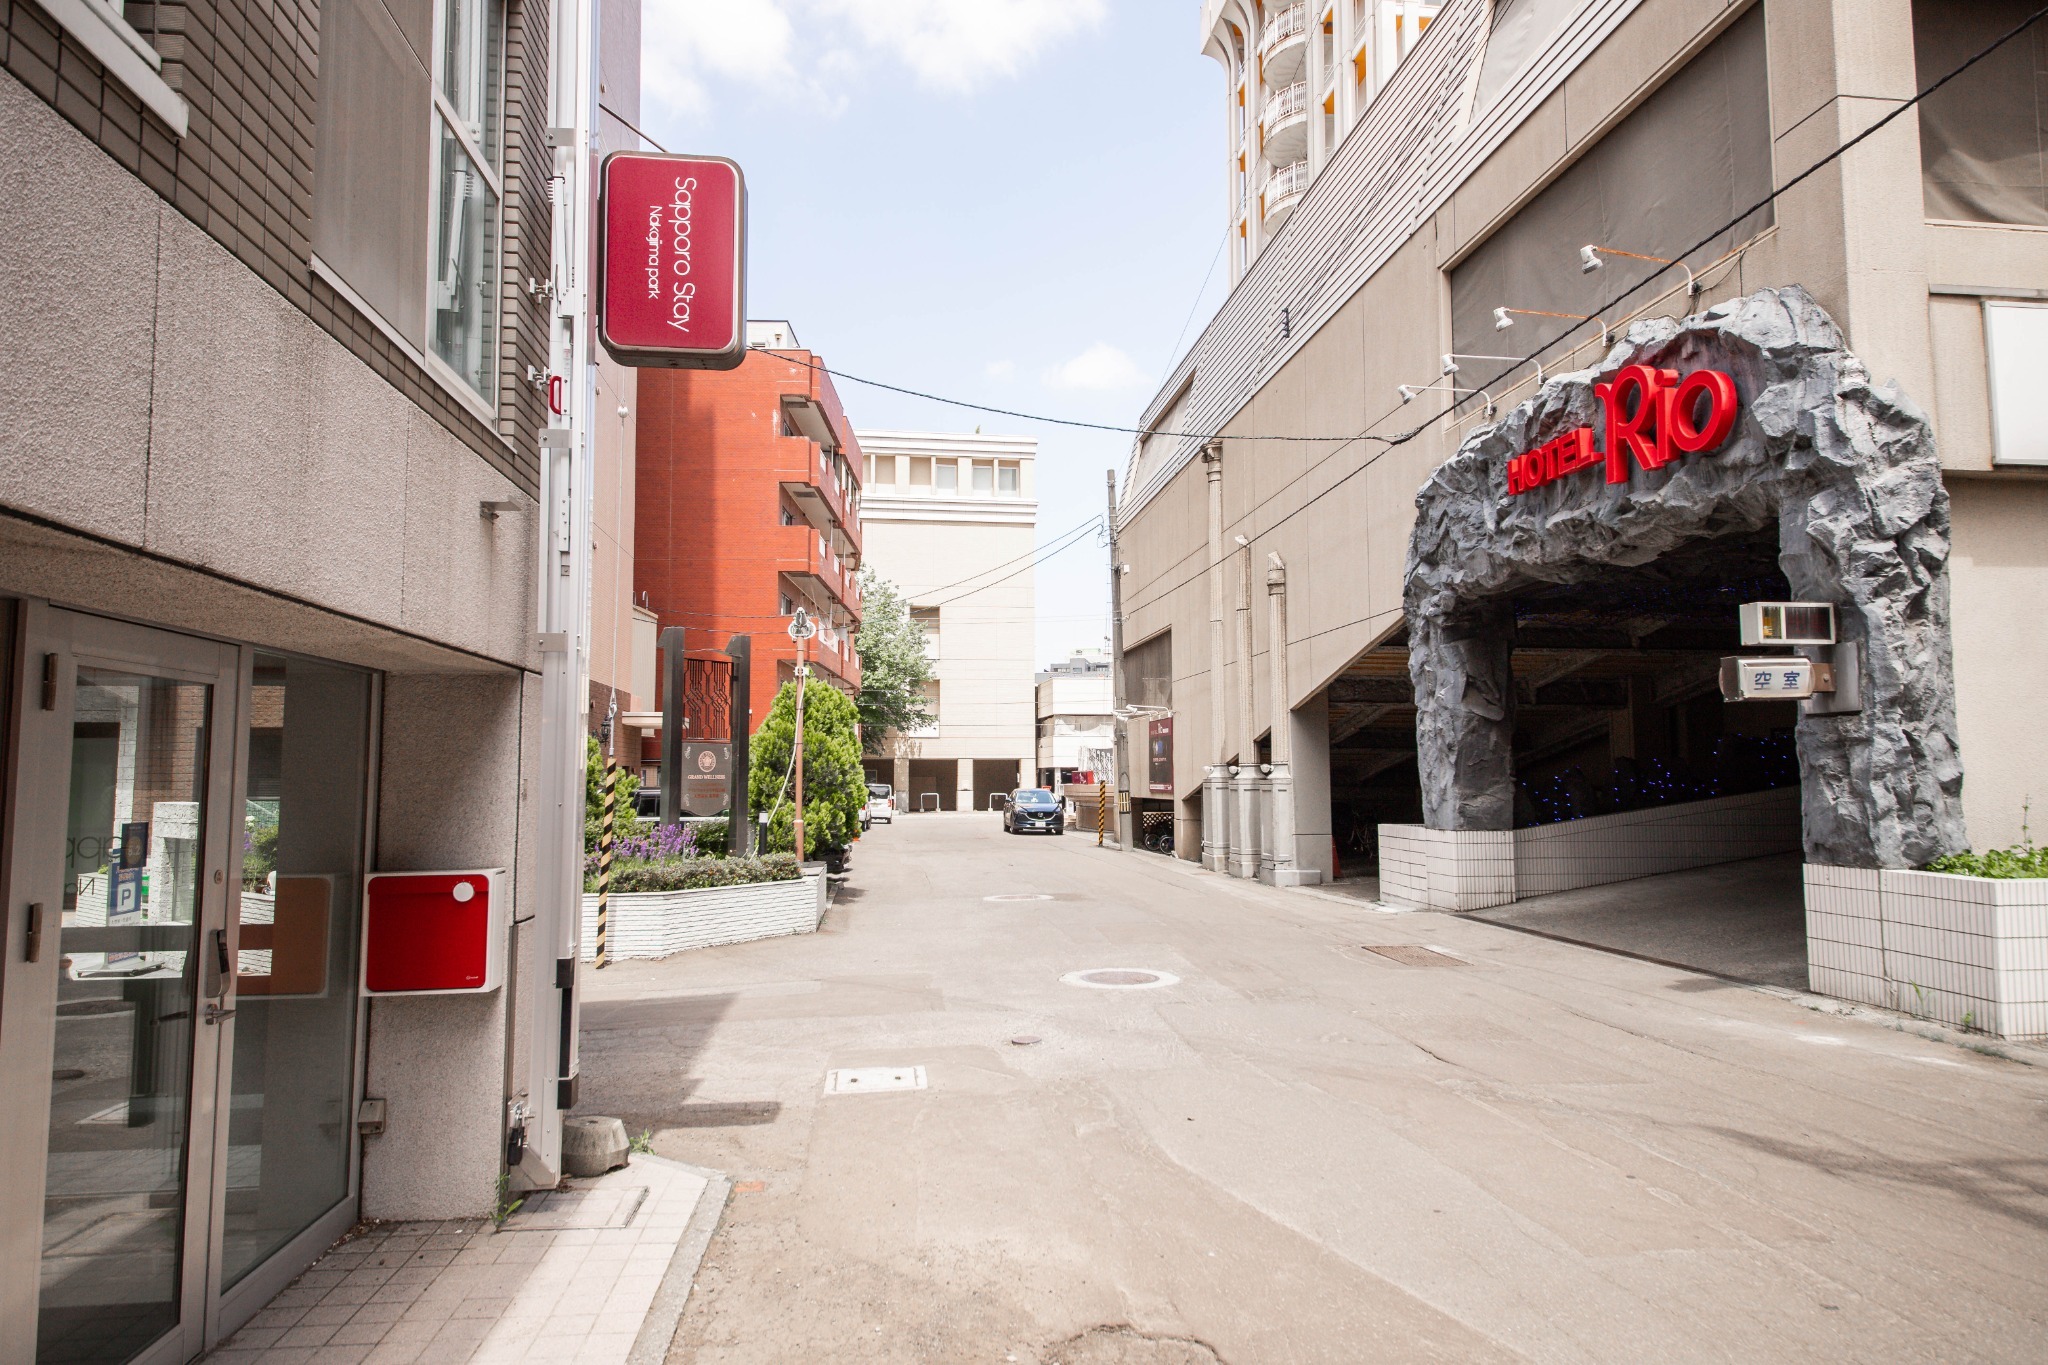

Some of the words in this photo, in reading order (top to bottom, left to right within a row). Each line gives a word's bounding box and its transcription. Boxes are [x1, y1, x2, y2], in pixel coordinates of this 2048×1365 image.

[645, 205, 663, 266] Nakajima
[668, 177, 698, 276] Sapporo
[645, 267, 660, 299] park
[667, 282, 695, 333] Stay
[1507, 427, 1605, 496] HOTEL
[1754, 671, 1801, 690] 空室
[121, 888, 131, 906] P
